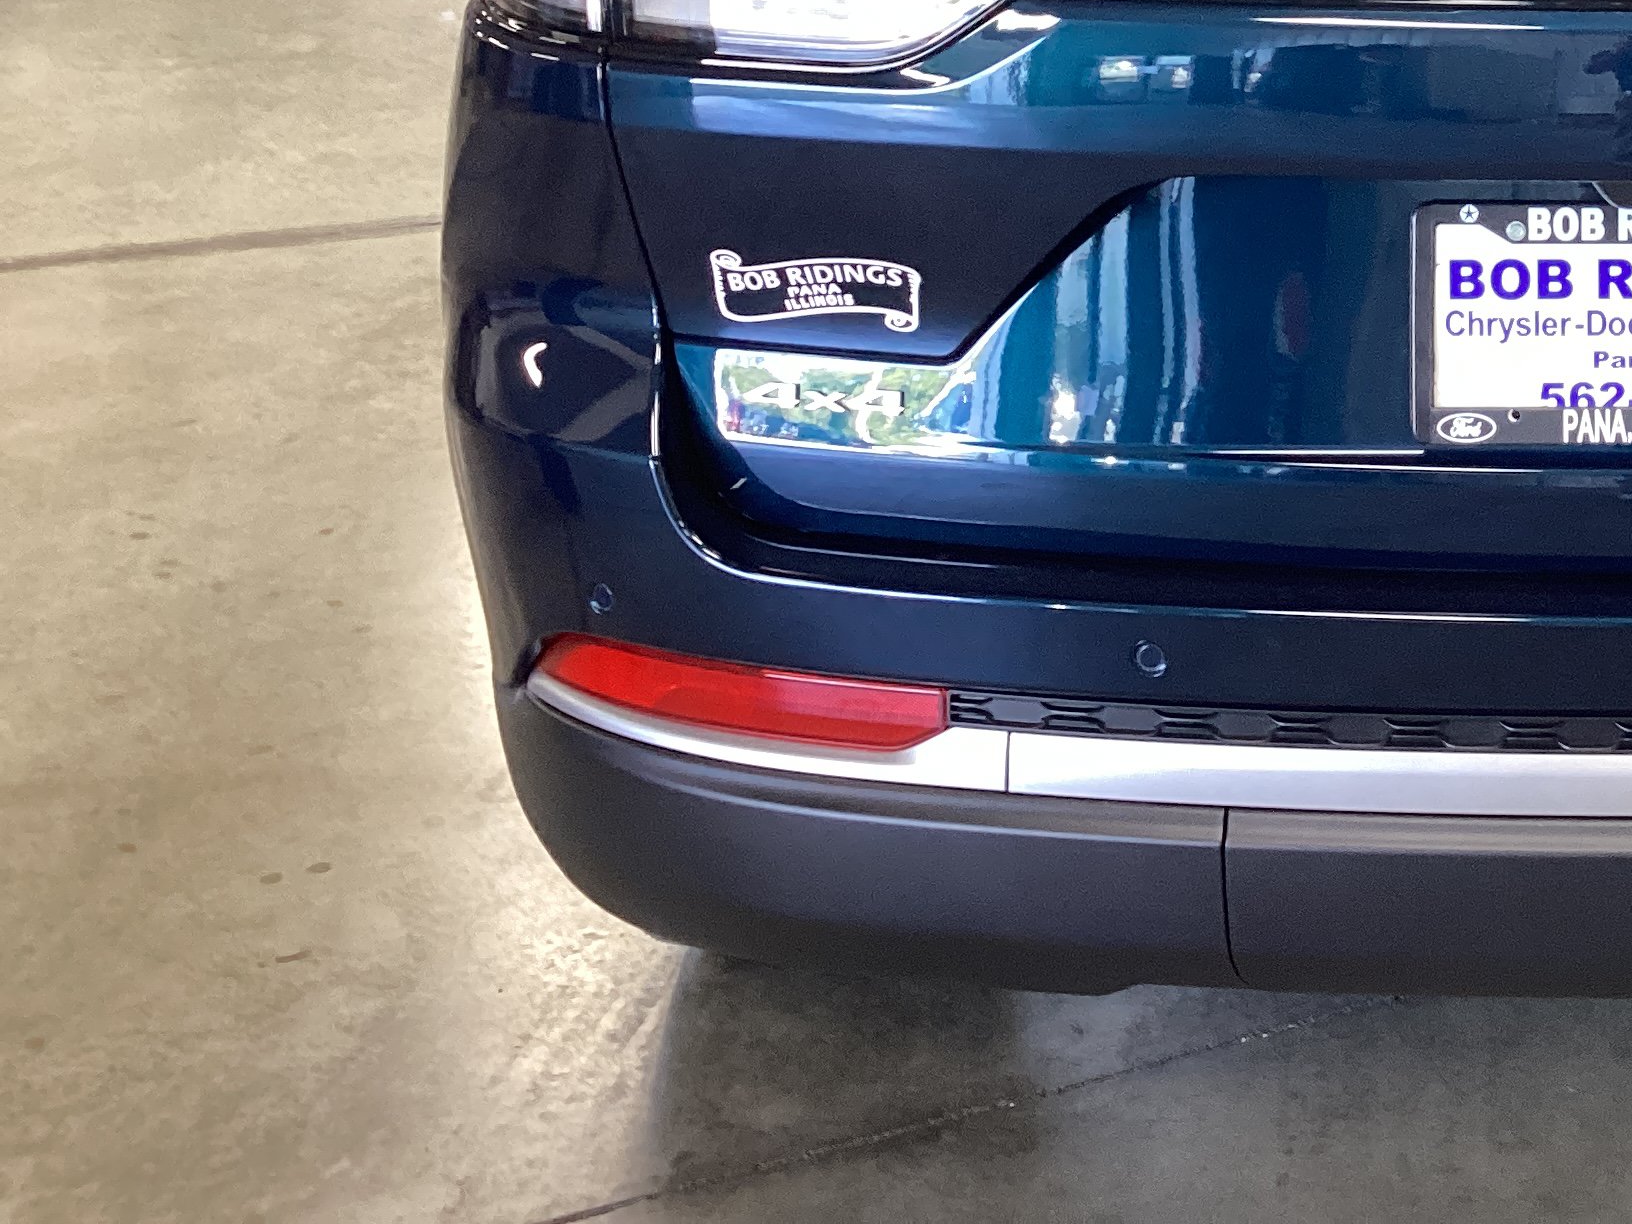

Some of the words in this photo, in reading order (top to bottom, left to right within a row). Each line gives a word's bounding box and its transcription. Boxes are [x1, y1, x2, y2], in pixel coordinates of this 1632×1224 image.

[1527, 206, 1606, 242] BOB
[726, 270, 781, 292] BOB
[785, 264, 904, 287] RIDINGS
[786, 283, 842, 298] PANA
[1448, 258, 1574, 300] BOB
[783, 293, 855, 311] ILLINOIS
[742, 381, 906, 416] 4x4
